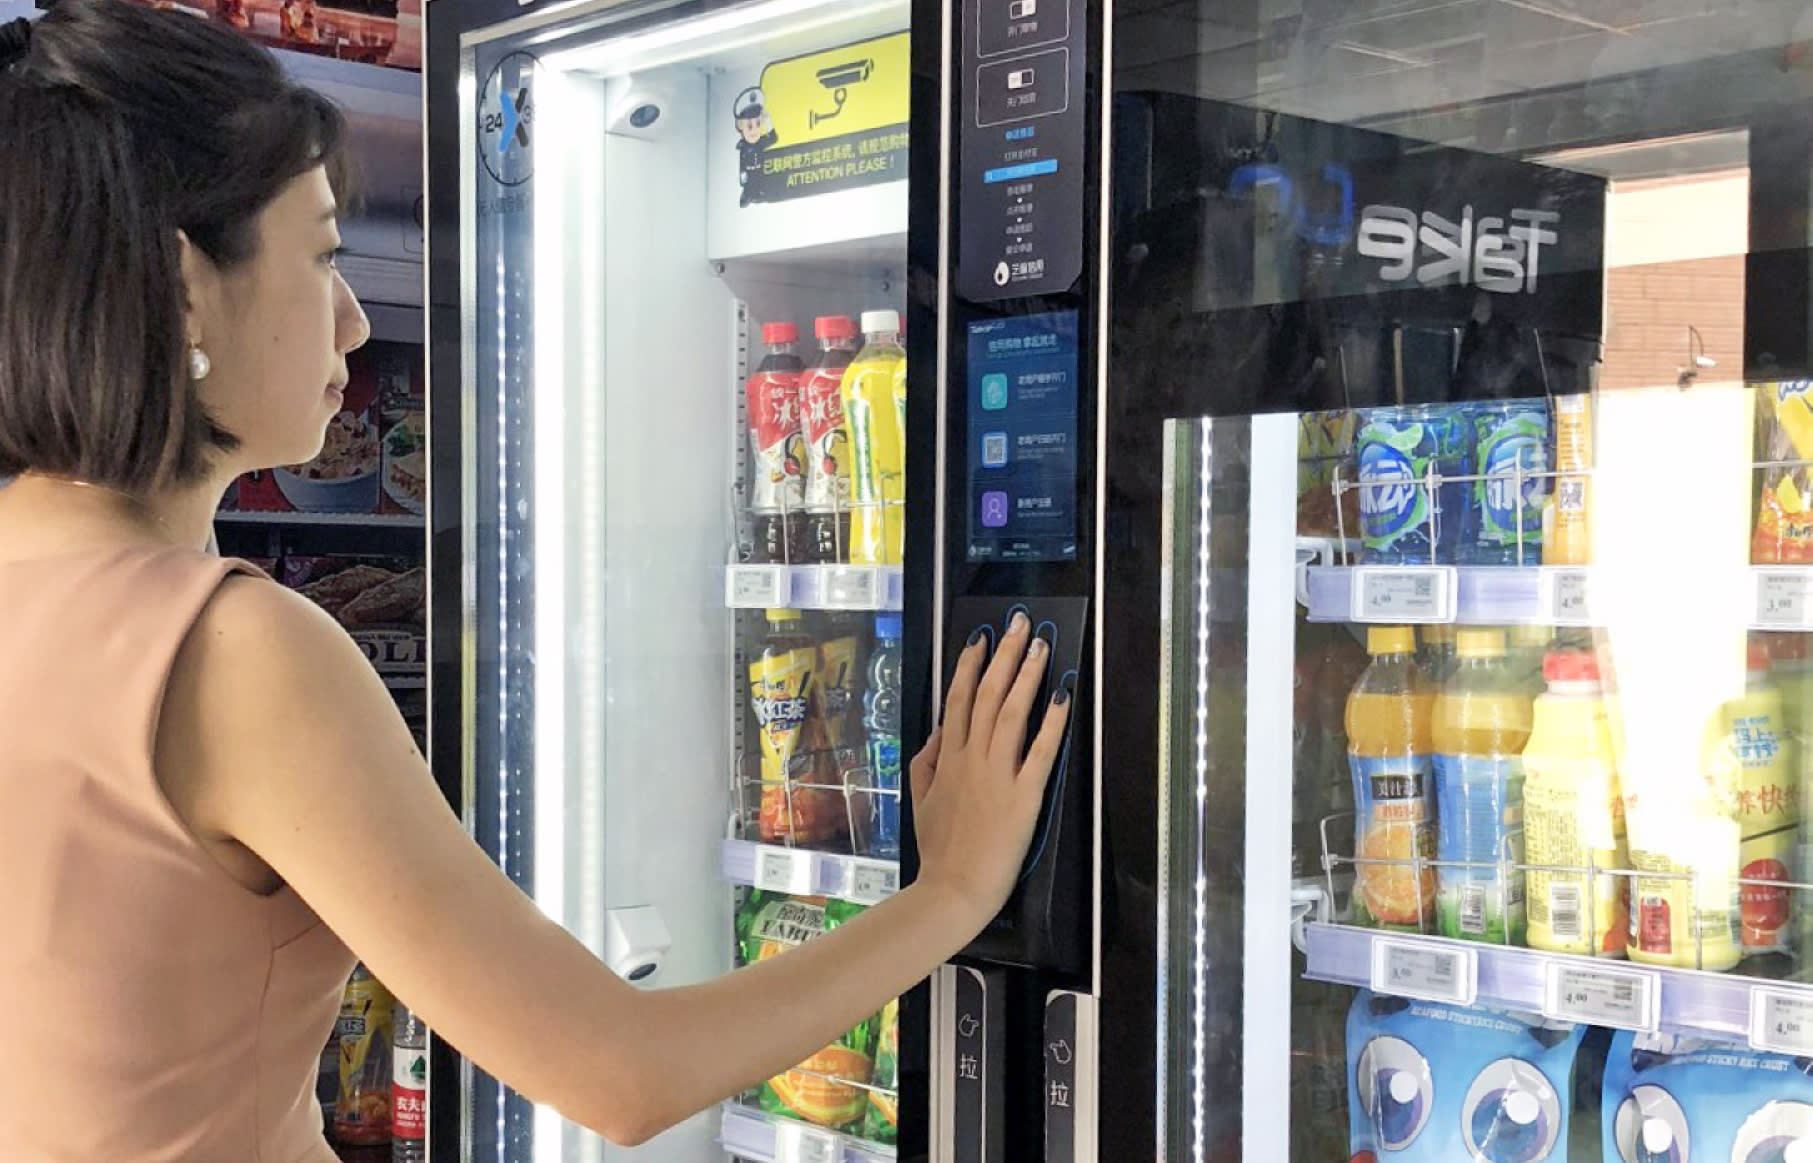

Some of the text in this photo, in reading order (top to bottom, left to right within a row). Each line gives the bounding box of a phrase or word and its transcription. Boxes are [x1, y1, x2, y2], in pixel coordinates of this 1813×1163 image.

[486, 112, 503, 133] 24
[786, 167, 844, 188] ATTENTION
[960, 1054, 978, 1080] 拉
[1050, 1080, 1070, 1107] 拉
